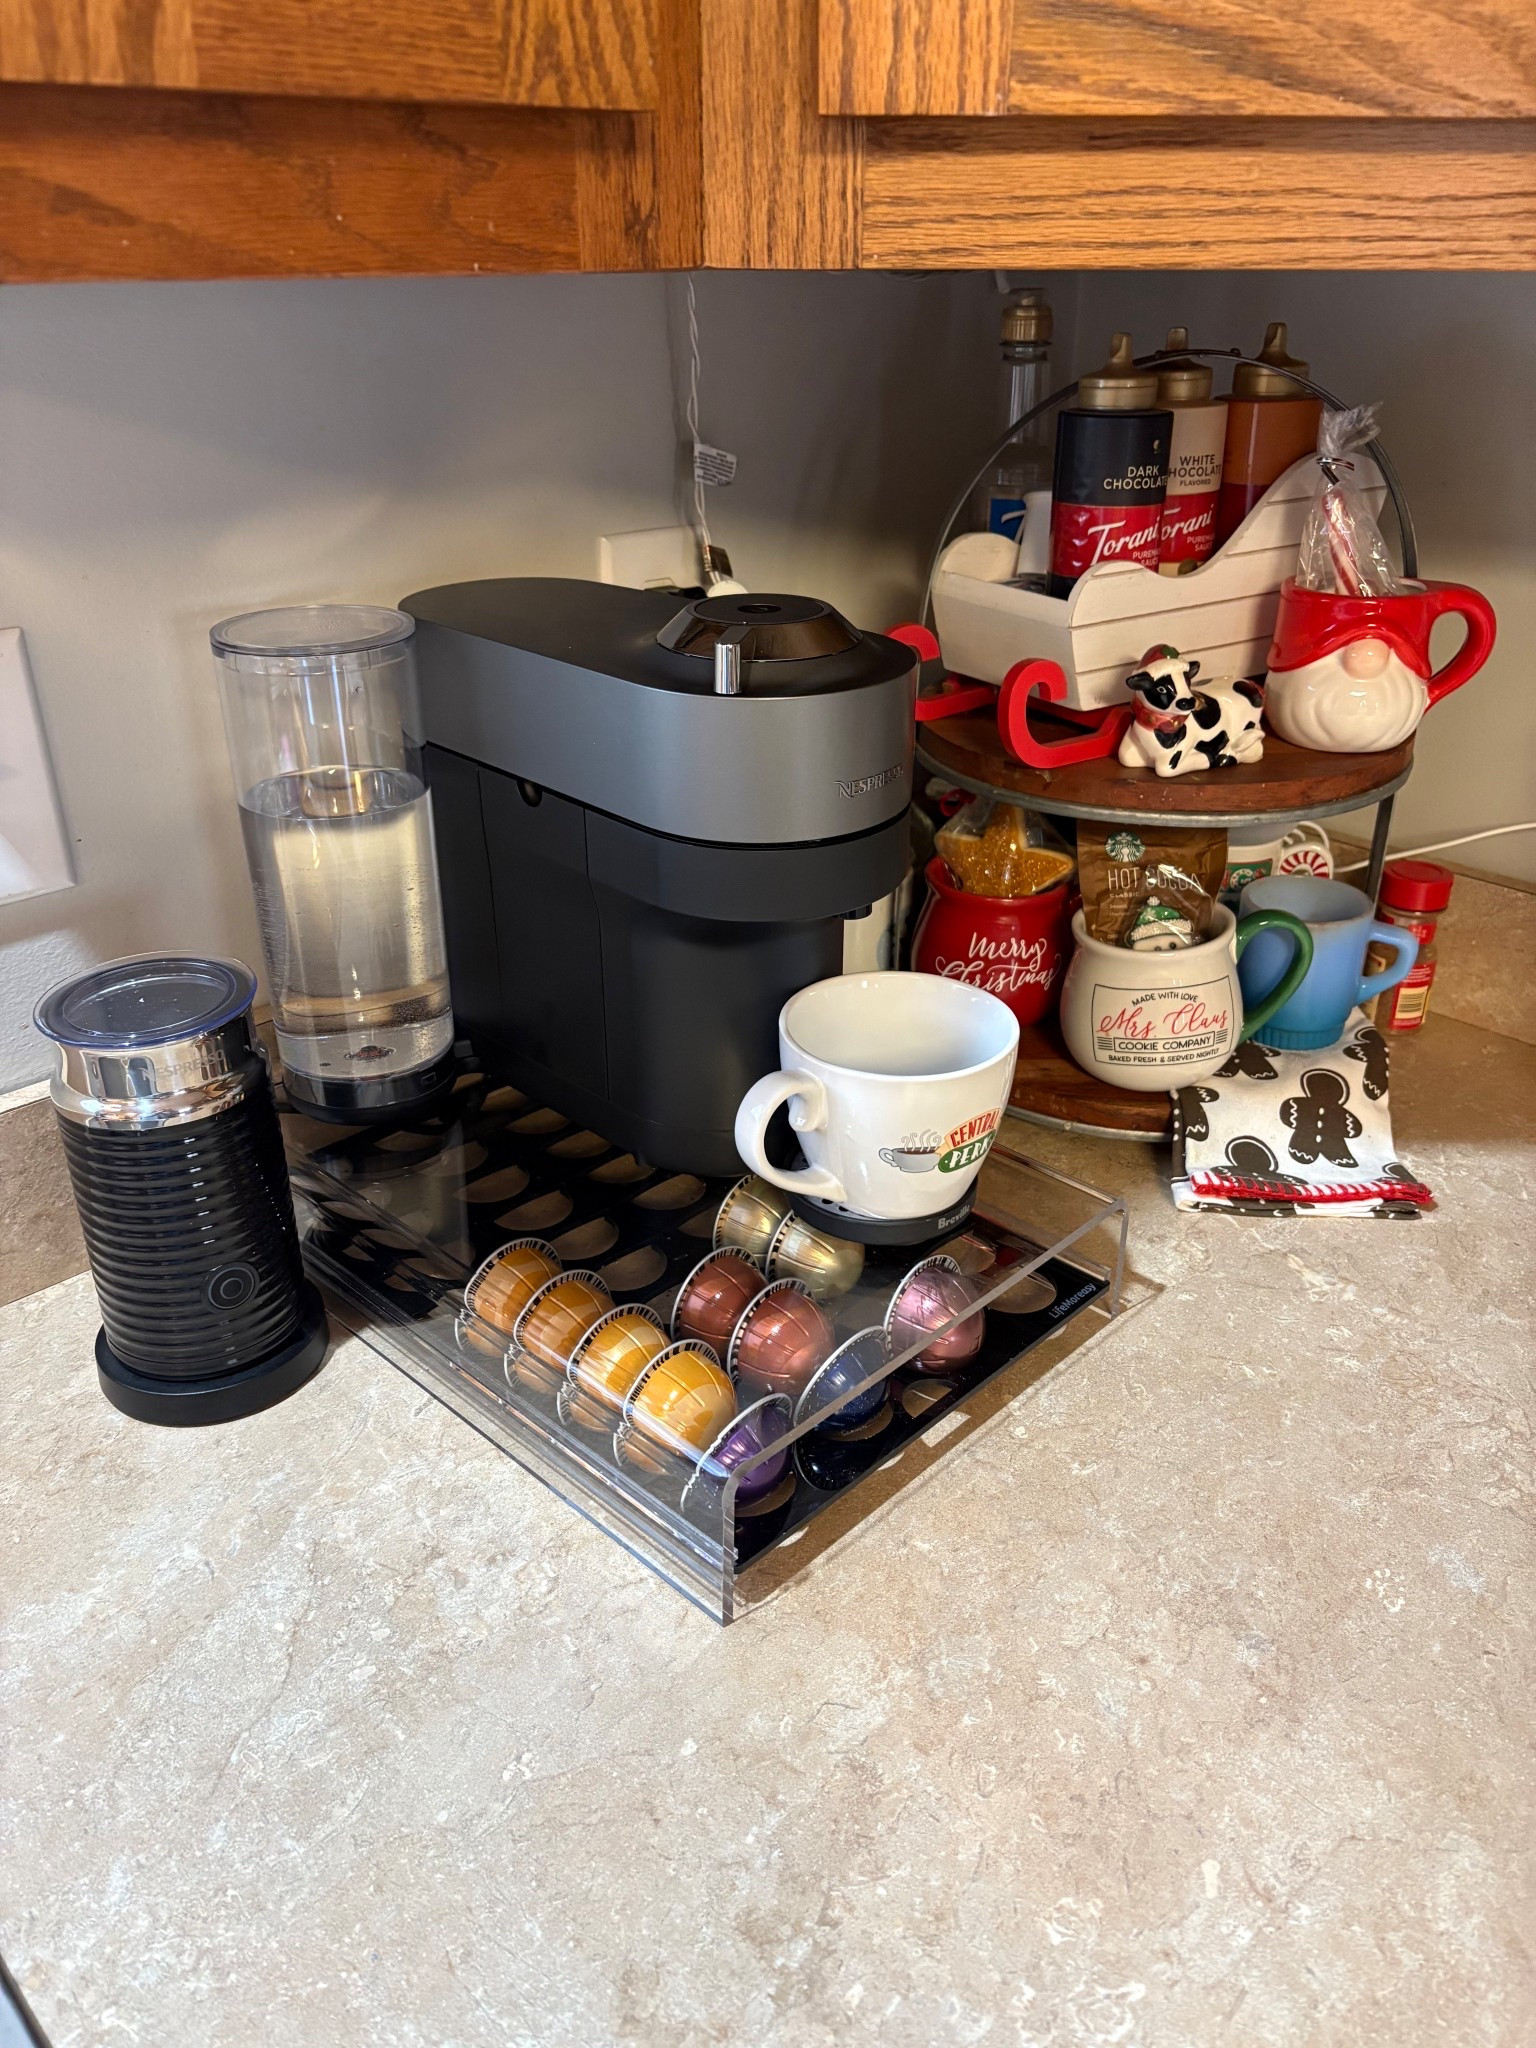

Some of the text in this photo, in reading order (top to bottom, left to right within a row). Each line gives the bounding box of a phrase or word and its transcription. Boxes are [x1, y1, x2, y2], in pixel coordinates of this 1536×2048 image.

[1127, 464, 1160, 478] DARK
[1168, 464, 1222, 478] HOCOLATE
[1179, 454, 1216, 467] WHITE
[1103, 474, 1168, 490] CHOCOLATE
[1179, 478, 1212, 487] FLAVORED
[1087, 516, 1160, 566] Torani
[1107, 866, 1140, 890] HOT
[967, 931, 1048, 972] Merry
[935, 953, 1061, 993] Christmas
[1131, 991, 1199, 1007] MADE WITH LOVE
[1163, 1002, 1228, 1035] Claus
[1108, 1047, 1220, 1063] BAKED FRESH & SERVED NIGHTLY
[1118, 1036, 1212, 1051] COOKIE COMPANY
[137, 1049, 225, 1082] NESPRESSO
[949, 1109, 1000, 1148] CENTRAL
[949, 1133, 993, 1169] PERK
[937, 1204, 971, 1230] Breville
[1048, 1282, 1097, 1319] LifeMoreasy
